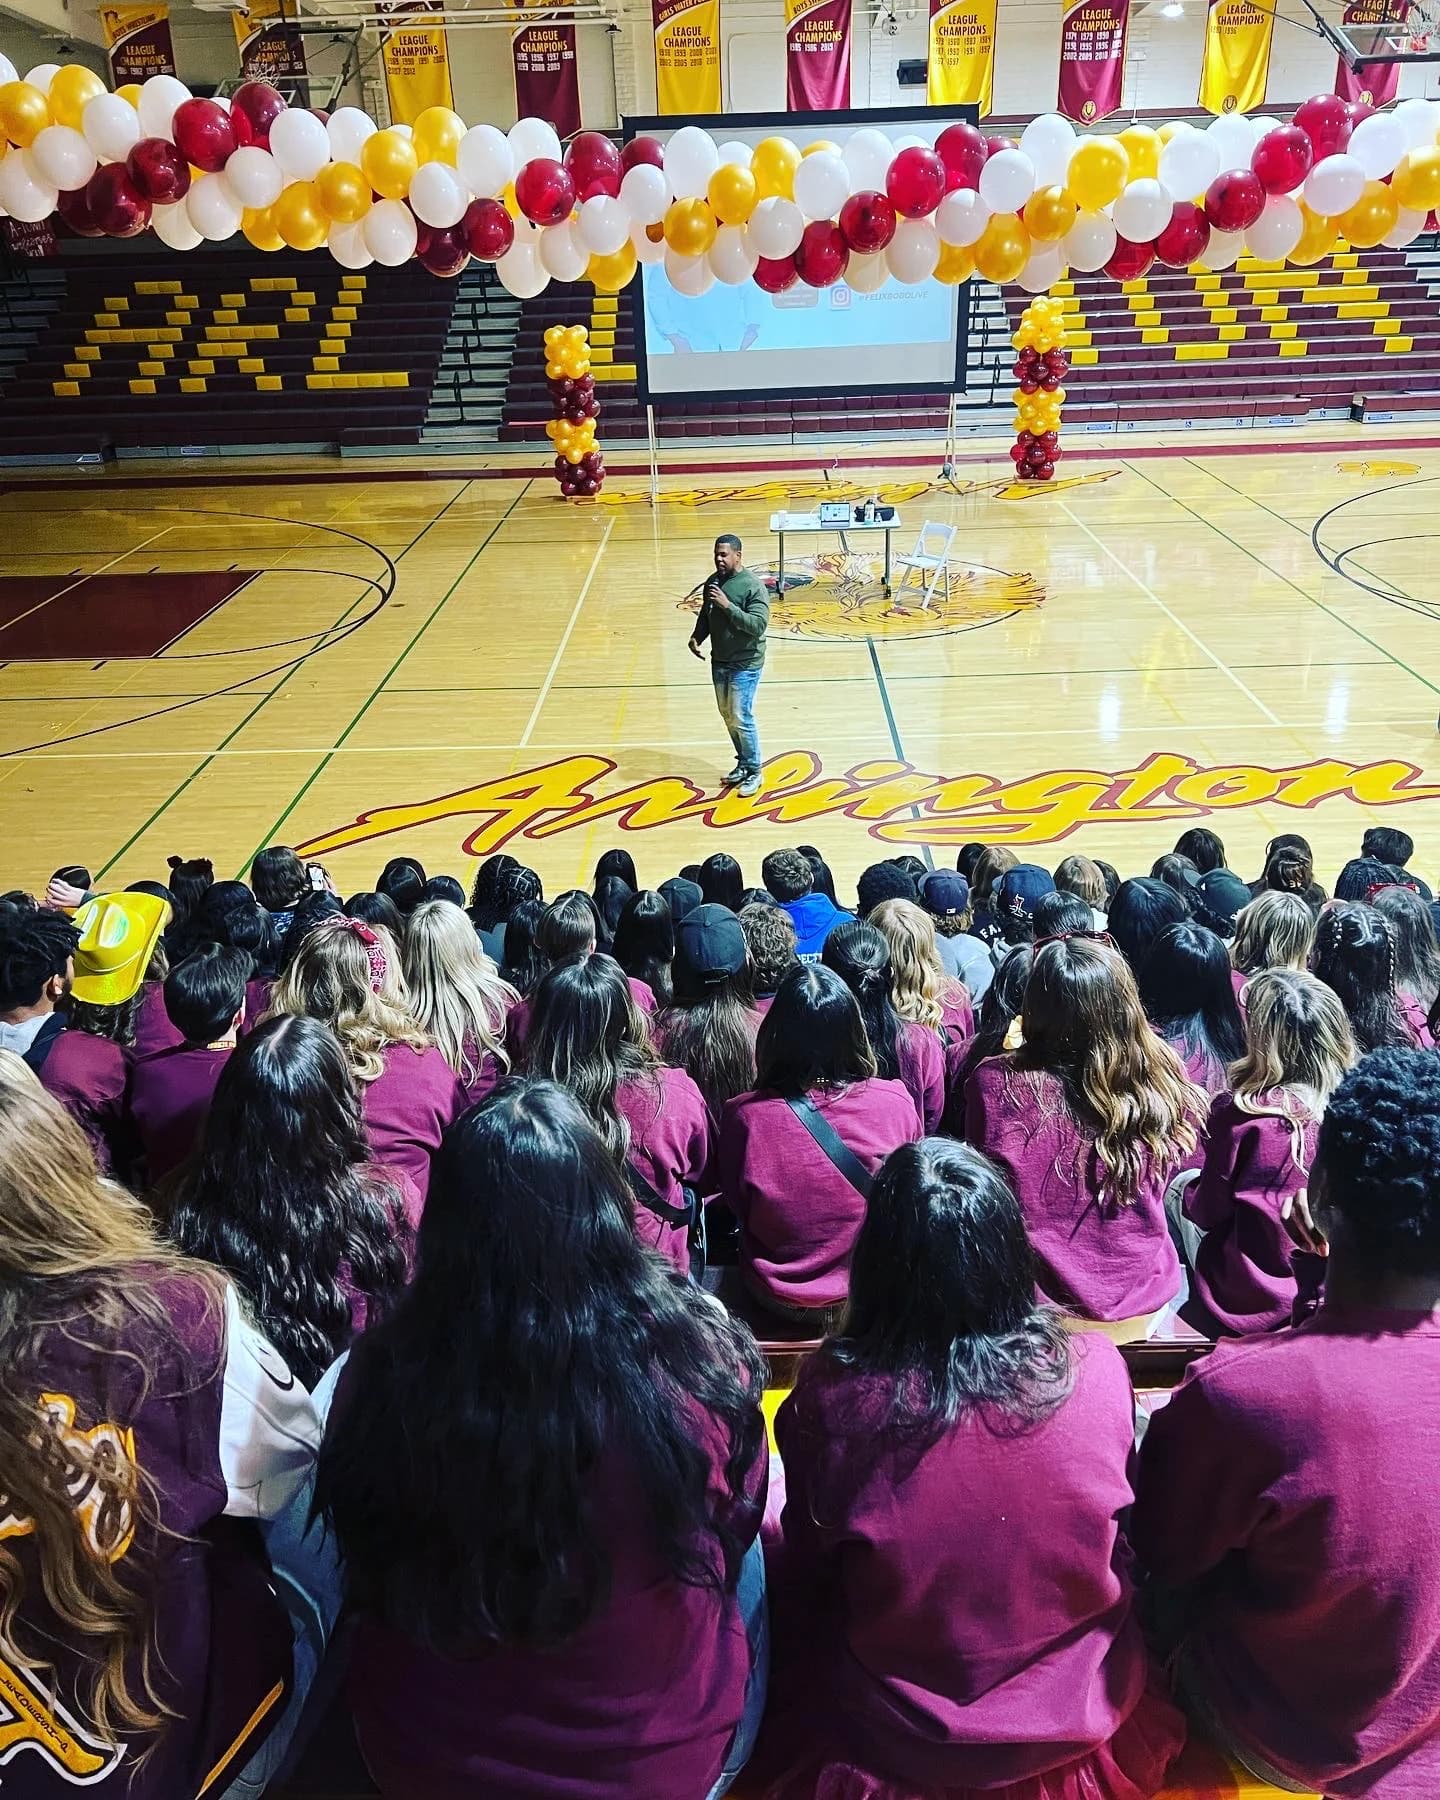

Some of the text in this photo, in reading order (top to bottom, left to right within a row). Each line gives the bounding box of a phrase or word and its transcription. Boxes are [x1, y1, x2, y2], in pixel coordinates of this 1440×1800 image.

[1081, 9, 1112, 20] LEAGUE
[1226, 4, 1256, 14] LEAGUE
[804, 20, 834, 31] LEAGUE
[948, 14, 978, 25] LEAGUE
[1071, 19, 1120, 31] CHAMPIONS
[1217, 14, 1265, 25] CHAMPIONS
[528, 30, 559, 41] LEAGUE
[672, 26, 702, 37] LEAGUE
[938, 24, 986, 36] CHAMPIONS
[398, 35, 429, 46] LEAGUE
[663, 36, 711, 48] CHAMPIONS
[794, 30, 843, 43] CHAMPIONS
[126, 44, 156, 56] LEAGUE
[391, 45, 439, 57] CHAMPIONS
[520, 40, 568, 52] CHAMPIONS
[120, 54, 167, 66] CHAMPIONS
[297, 752, 1440, 857] Arlington
[3, 1678, 69, 1755] LEADERSHIP
